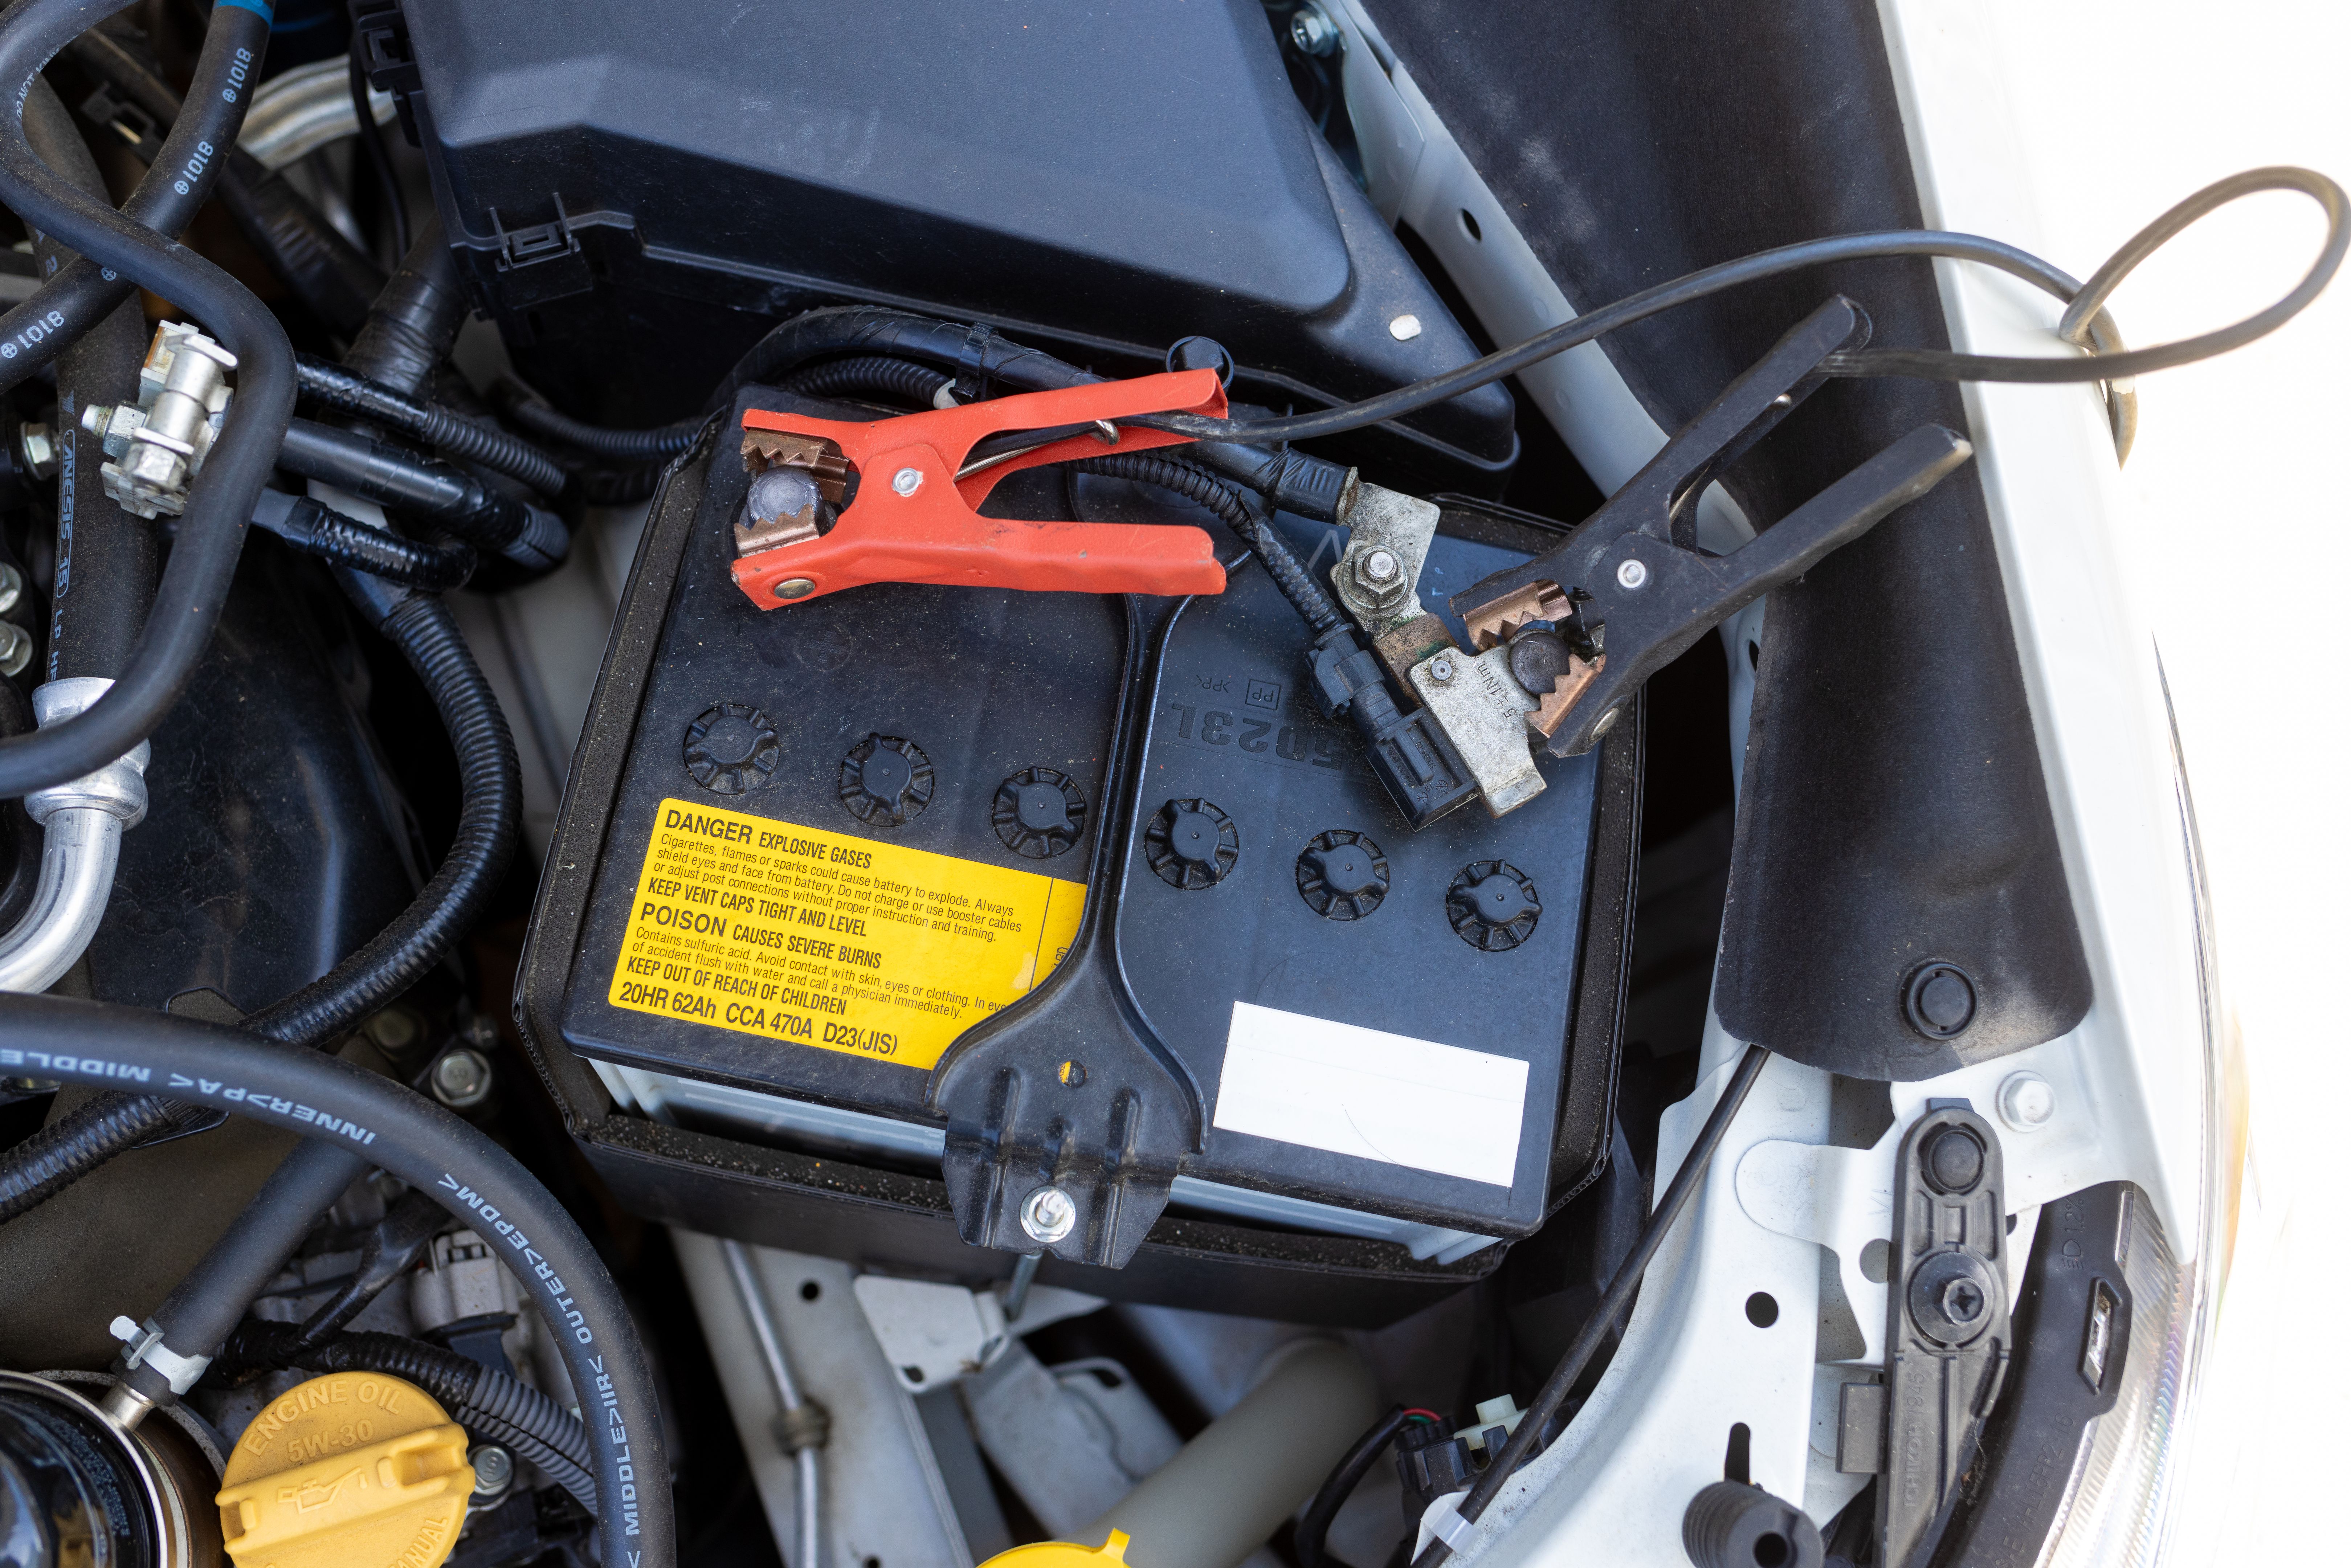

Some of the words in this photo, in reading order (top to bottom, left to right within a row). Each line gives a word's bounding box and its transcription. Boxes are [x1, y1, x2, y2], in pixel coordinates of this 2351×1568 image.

[230, 48, 252, 89] 8101
[184, 141, 213, 182] 8101
[18, 311, 64, 349] 8101
[61, 444, 73, 540] ANESIS
[59, 556, 68, 587] 15
[54, 609, 62, 638] LP
[50, 651, 60, 681] HF
[1252, 691, 1274, 703] PP
[665, 809, 753, 845] DANGER
[759, 831, 828, 860] EXPLOSIVE
[830, 846, 872, 869] GASES
[654, 863, 666, 873] or
[668, 865, 700, 880] adjust
[702, 873, 726, 885] post
[728, 878, 789, 898] connections
[793, 891, 833, 907] without
[835, 900, 870, 915] proper
[873, 908, 928, 926] instruction
[931, 920, 951, 932] and
[954, 923, 996, 943] training.
[657, 848, 689, 863] shield
[691, 856, 716, 869] eyes
[719, 862, 739, 874] and
[742, 864, 763, 879] face
[767, 870, 792, 885] from
[794, 875, 835, 894] battery.
[837, 884, 852, 897] Do
[854, 890, 872, 902] not
[874, 893, 909, 910] charge
[912, 902, 924, 912] or
[926, 905, 944, 916] use
[947, 907, 986, 925] booster
[988, 917, 1021, 932] cables
[661, 833, 717, 857] Cigarettes,
[722, 846, 757, 863] flames
[759, 856, 772, 866] or
[773, 859, 808, 874] sparks
[810, 866, 839, 880] could
[841, 873, 870, 887] cause
[873, 877, 912, 897] battery
[915, 886, 925, 898] to
[928, 891, 971, 908] explode.
[974, 898, 1014, 917] Always
[640, 902, 727, 937] POISON
[733, 924, 784, 949] CAUSES
[787, 935, 836, 960] SEVERE
[838, 945, 882, 969] BURNS
[648, 877, 682, 898] KEEP
[685, 884, 719, 906] VENT
[720, 891, 755, 914] CAPS
[759, 899, 797, 922] TIGHT
[797, 908, 826, 928] AND
[828, 914, 866, 937] LEVEL
[626, 956, 661, 976] KEEP
[663, 963, 692, 983] OUT
[693, 969, 712, 987] OF
[713, 973, 758, 997] REACH
[760, 983, 779, 1001] OF
[781, 987, 847, 1016] CHILDREN
[632, 942, 645, 952] of
[647, 946, 692, 963] accident
[695, 953, 721, 969] flush
[725, 961, 749, 974] with
[754, 967, 784, 981] water
[787, 974, 807, 986] and
[810, 979, 829, 989] call
[832, 984, 838, 992] a
[841, 984, 891, 1003] physician
[894, 996, 963, 1020] immediately.
[636, 926, 682, 946] Contains
[684, 939, 725, 955] sulfuric
[728, 948, 752, 961] acid.
[755, 951, 787, 968] Avoid
[789, 960, 828, 976] contact
[832, 969, 855, 981] with
[858, 973, 882, 990] skin,
[885, 981, 909, 993] eyes
[912, 987, 924, 996] or
[926, 988, 970, 1008] clothing.
[975, 996, 985, 1009] In
[619, 981, 669, 1009] 20HR
[672, 992, 717, 1019] 62Ah
[726, 1002, 764, 1029] CCA
[770, 1012, 812, 1039] 470A
[823, 1022, 898, 1056] D23(JIS)
[243, 1380, 347, 1457] ENGINE
[357, 1380, 400, 1415] OIL
[1906, 1371, 1925, 1414] 1945
[287, 1419, 374, 1463] 5W-30
[2054, 1412, 2075, 1436] 16
[389, 1518, 448, 1568] ANUAL
